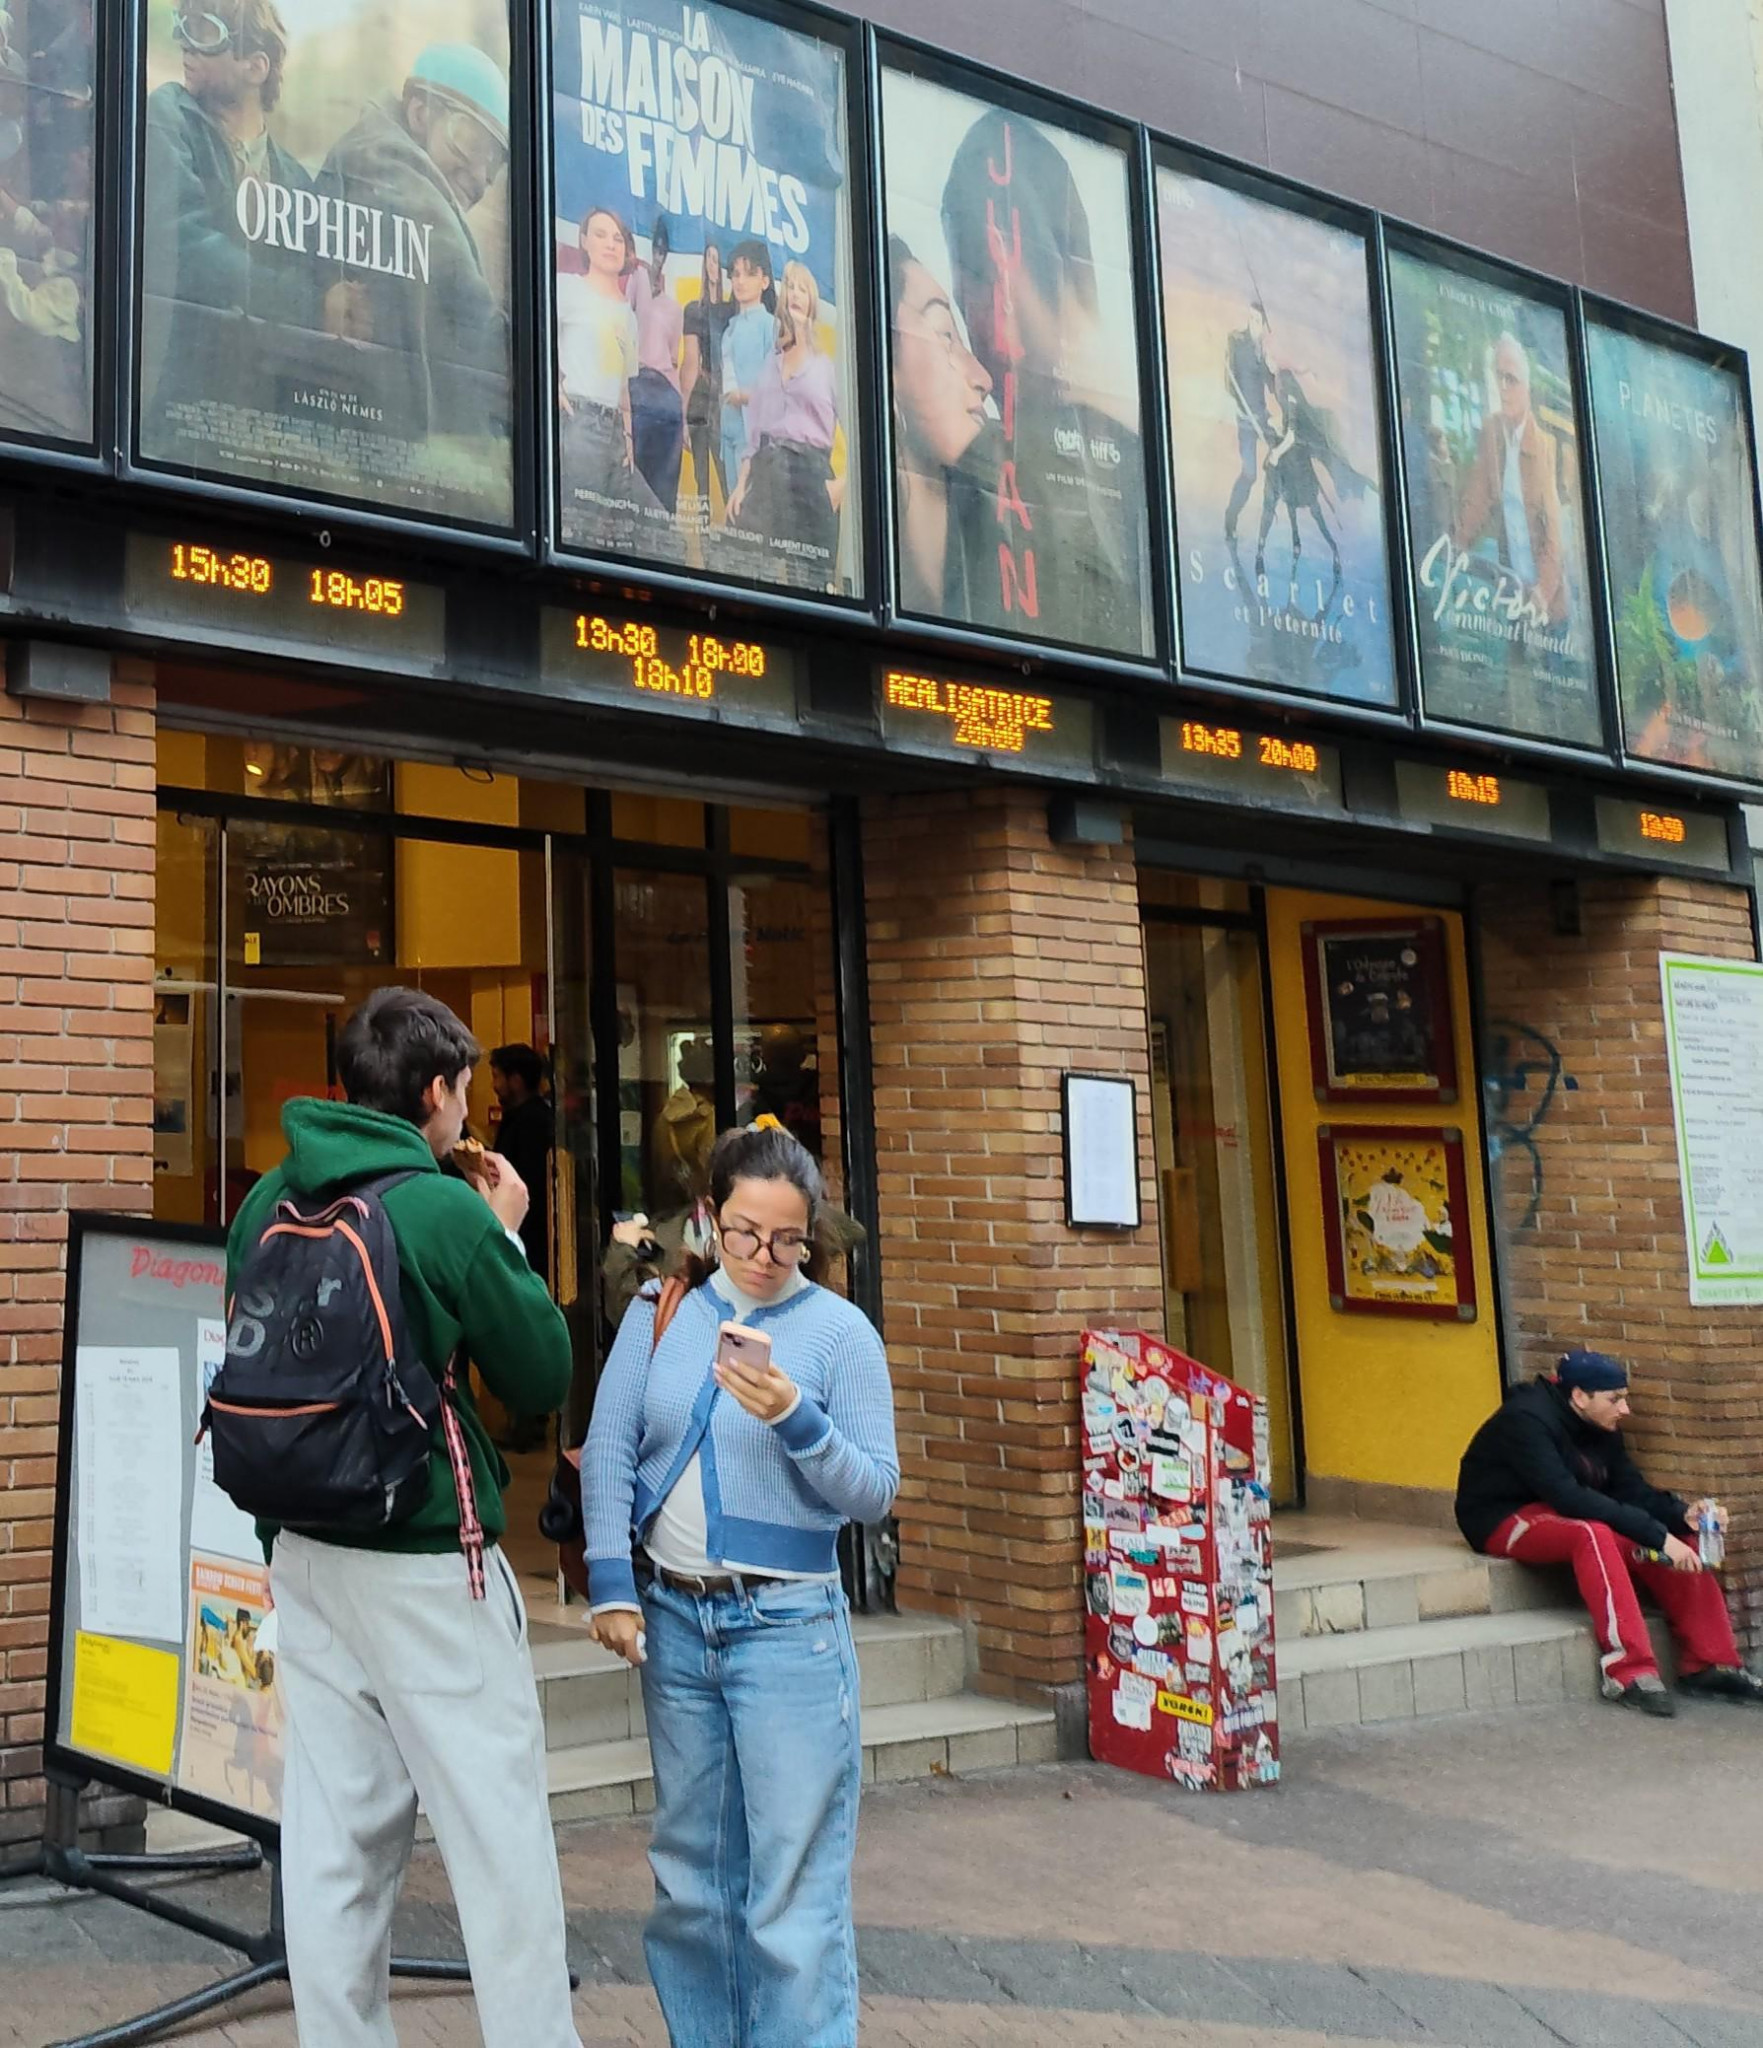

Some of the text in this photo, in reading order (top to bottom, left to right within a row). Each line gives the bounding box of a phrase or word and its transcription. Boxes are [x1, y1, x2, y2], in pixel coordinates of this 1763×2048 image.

[683, 6, 711, 52] LA
[580, 15, 755, 154] MAISON
[580, 100, 810, 254] DES FEMMES
[236, 176, 433, 285] ORPHELIN
[173, 544, 404, 615] 15h30 18h05
[1190, 551, 1377, 625] Scarlet
[575, 614, 766, 678] 13h30 18h00
[1234, 604, 1250, 624] et
[635, 656, 712, 698] 18h10
[1259, 736, 1318, 772] 20h00
[267, 894, 350, 917] OMBRES
